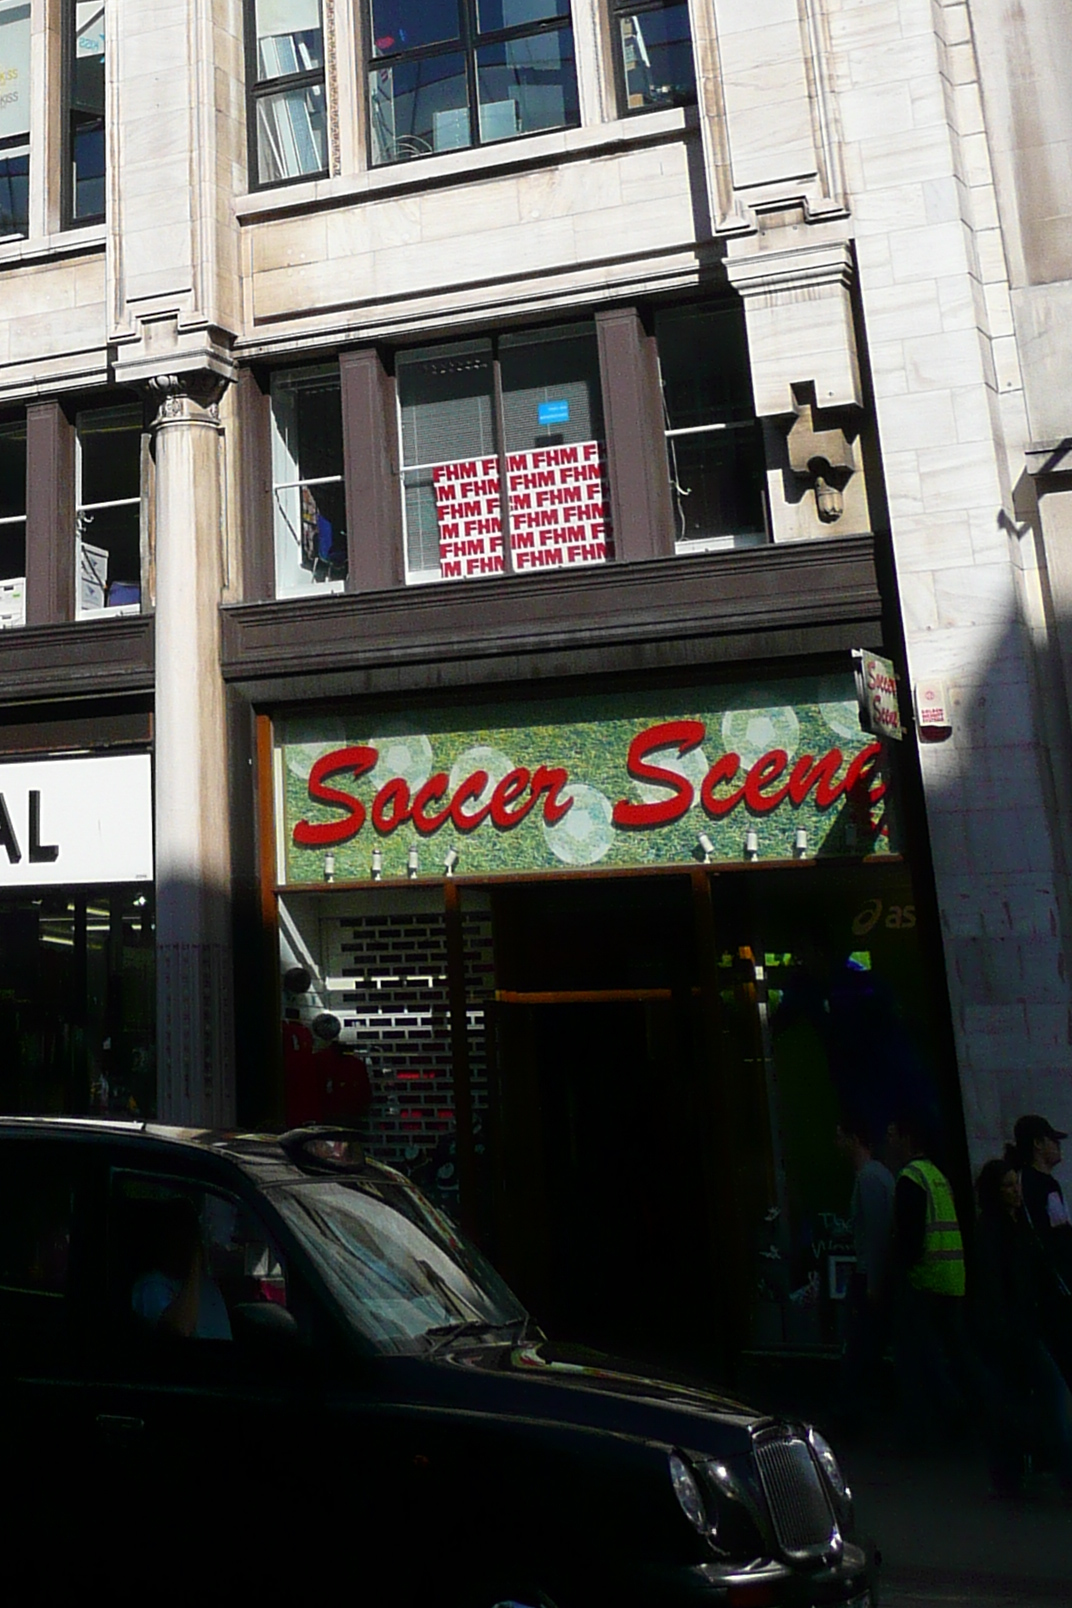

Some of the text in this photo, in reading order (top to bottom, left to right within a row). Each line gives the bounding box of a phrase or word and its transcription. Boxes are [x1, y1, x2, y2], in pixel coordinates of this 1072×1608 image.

[433, 462, 477, 483] FHM
[532, 447, 578, 469] FHM
[510, 470, 555, 491] FHM
[437, 500, 482, 521] FHM
[536, 486, 581, 507] FHM
[514, 509, 559, 530] FHM
[440, 539, 485, 559] FHM
[539, 526, 586, 546] FHM
[517, 548, 562, 569] FHM
[293, 745, 574, 847] Soccer
